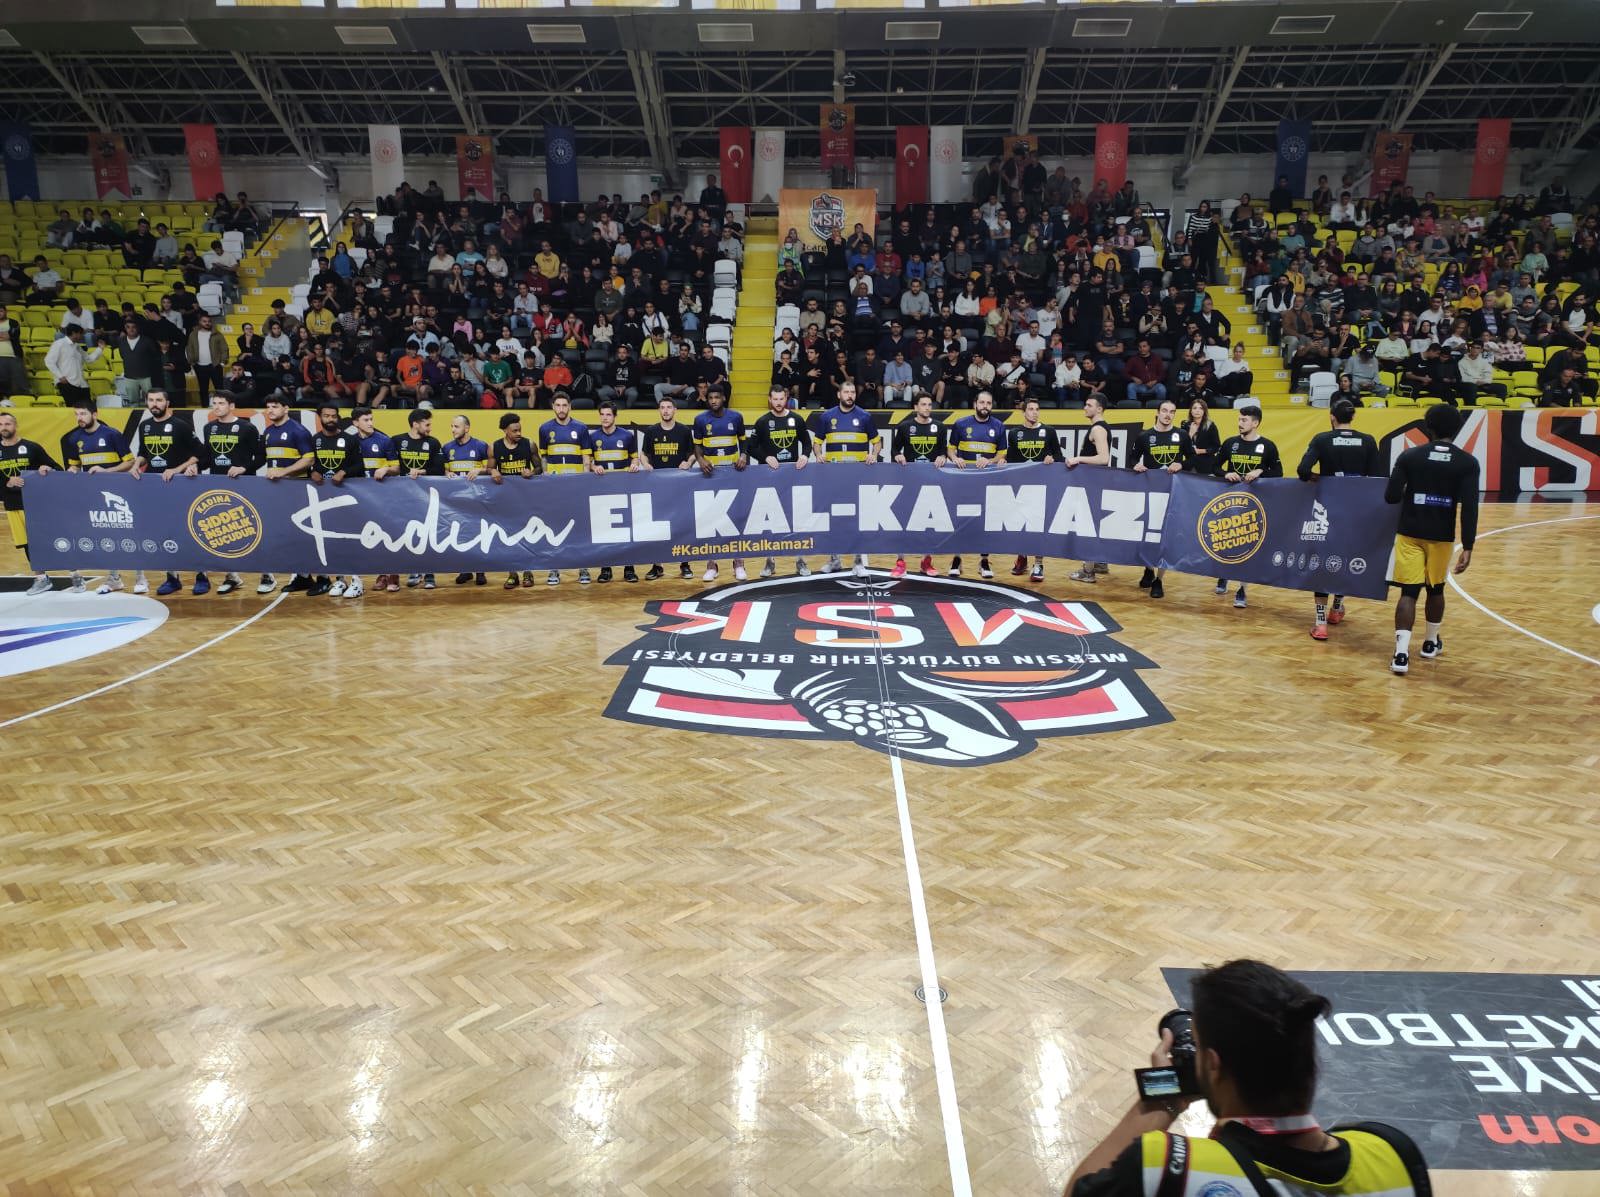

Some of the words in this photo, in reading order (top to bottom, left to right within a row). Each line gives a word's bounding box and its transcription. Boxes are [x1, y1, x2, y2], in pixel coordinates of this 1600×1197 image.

[812, 213, 843, 227] MSK
[196, 495, 231, 514] KADINA
[1211, 498, 1249, 514] KADINA
[89, 510, 134, 523] KADES
[589, 493, 671, 544] EL
[694, 484, 1170, 543] KAL-KA-MAZ!
[856, 590, 892, 598] 2019
[652, 601, 1108, 648] MSK
[632, 649, 792, 665] BELEDİYESİ
[809, 651, 1001, 668] BÜYÜKŞEHİR
[1015, 651, 1129, 666] MERSİN
